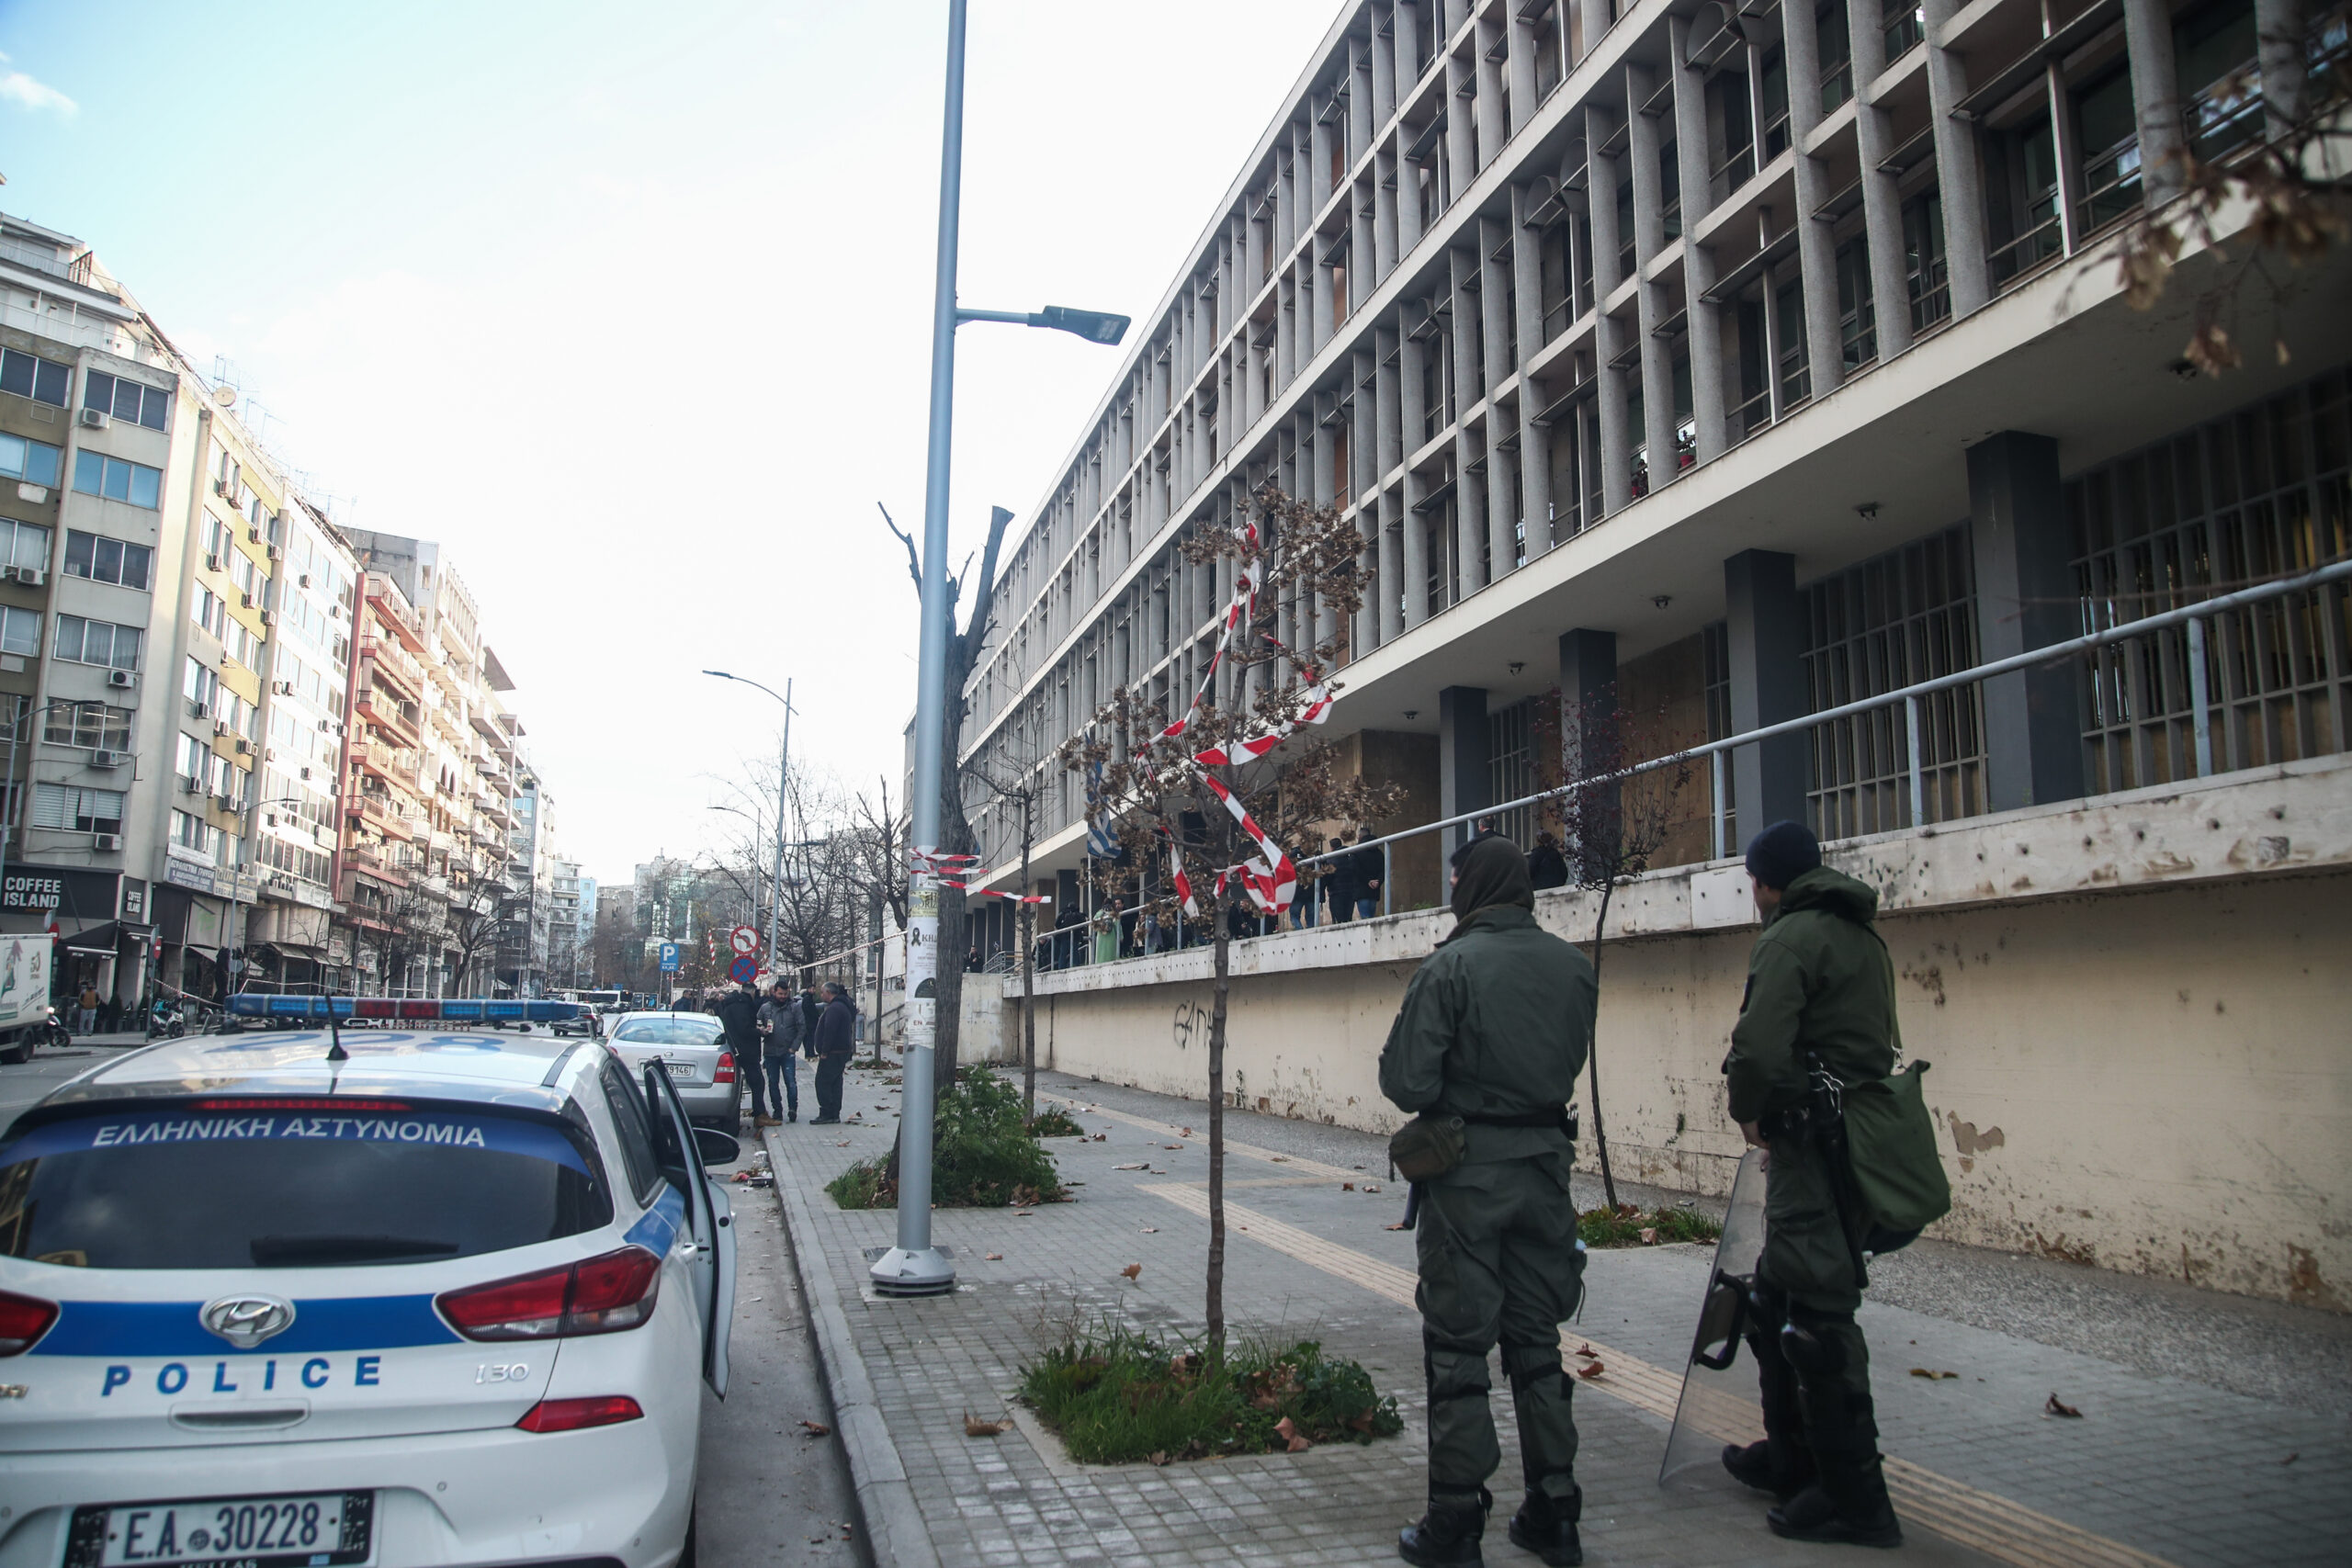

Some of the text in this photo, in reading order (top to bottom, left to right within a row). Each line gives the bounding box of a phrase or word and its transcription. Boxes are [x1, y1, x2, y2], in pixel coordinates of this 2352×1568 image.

[5, 876, 62, 894] COFFEE
[4, 892, 60, 908] ISLAND
[128, 890, 142, 903] COFFEE
[127, 901, 141, 913] ISLAND
[662, 945, 675, 962] P
[92, 1117, 486, 1148] ΕΛΛΗΝΙΚΗ ΑΣΤΥΝΟΜΙΑ
[101, 1355, 382, 1396] POLICE
[212, 1501, 321, 1553] 30228
